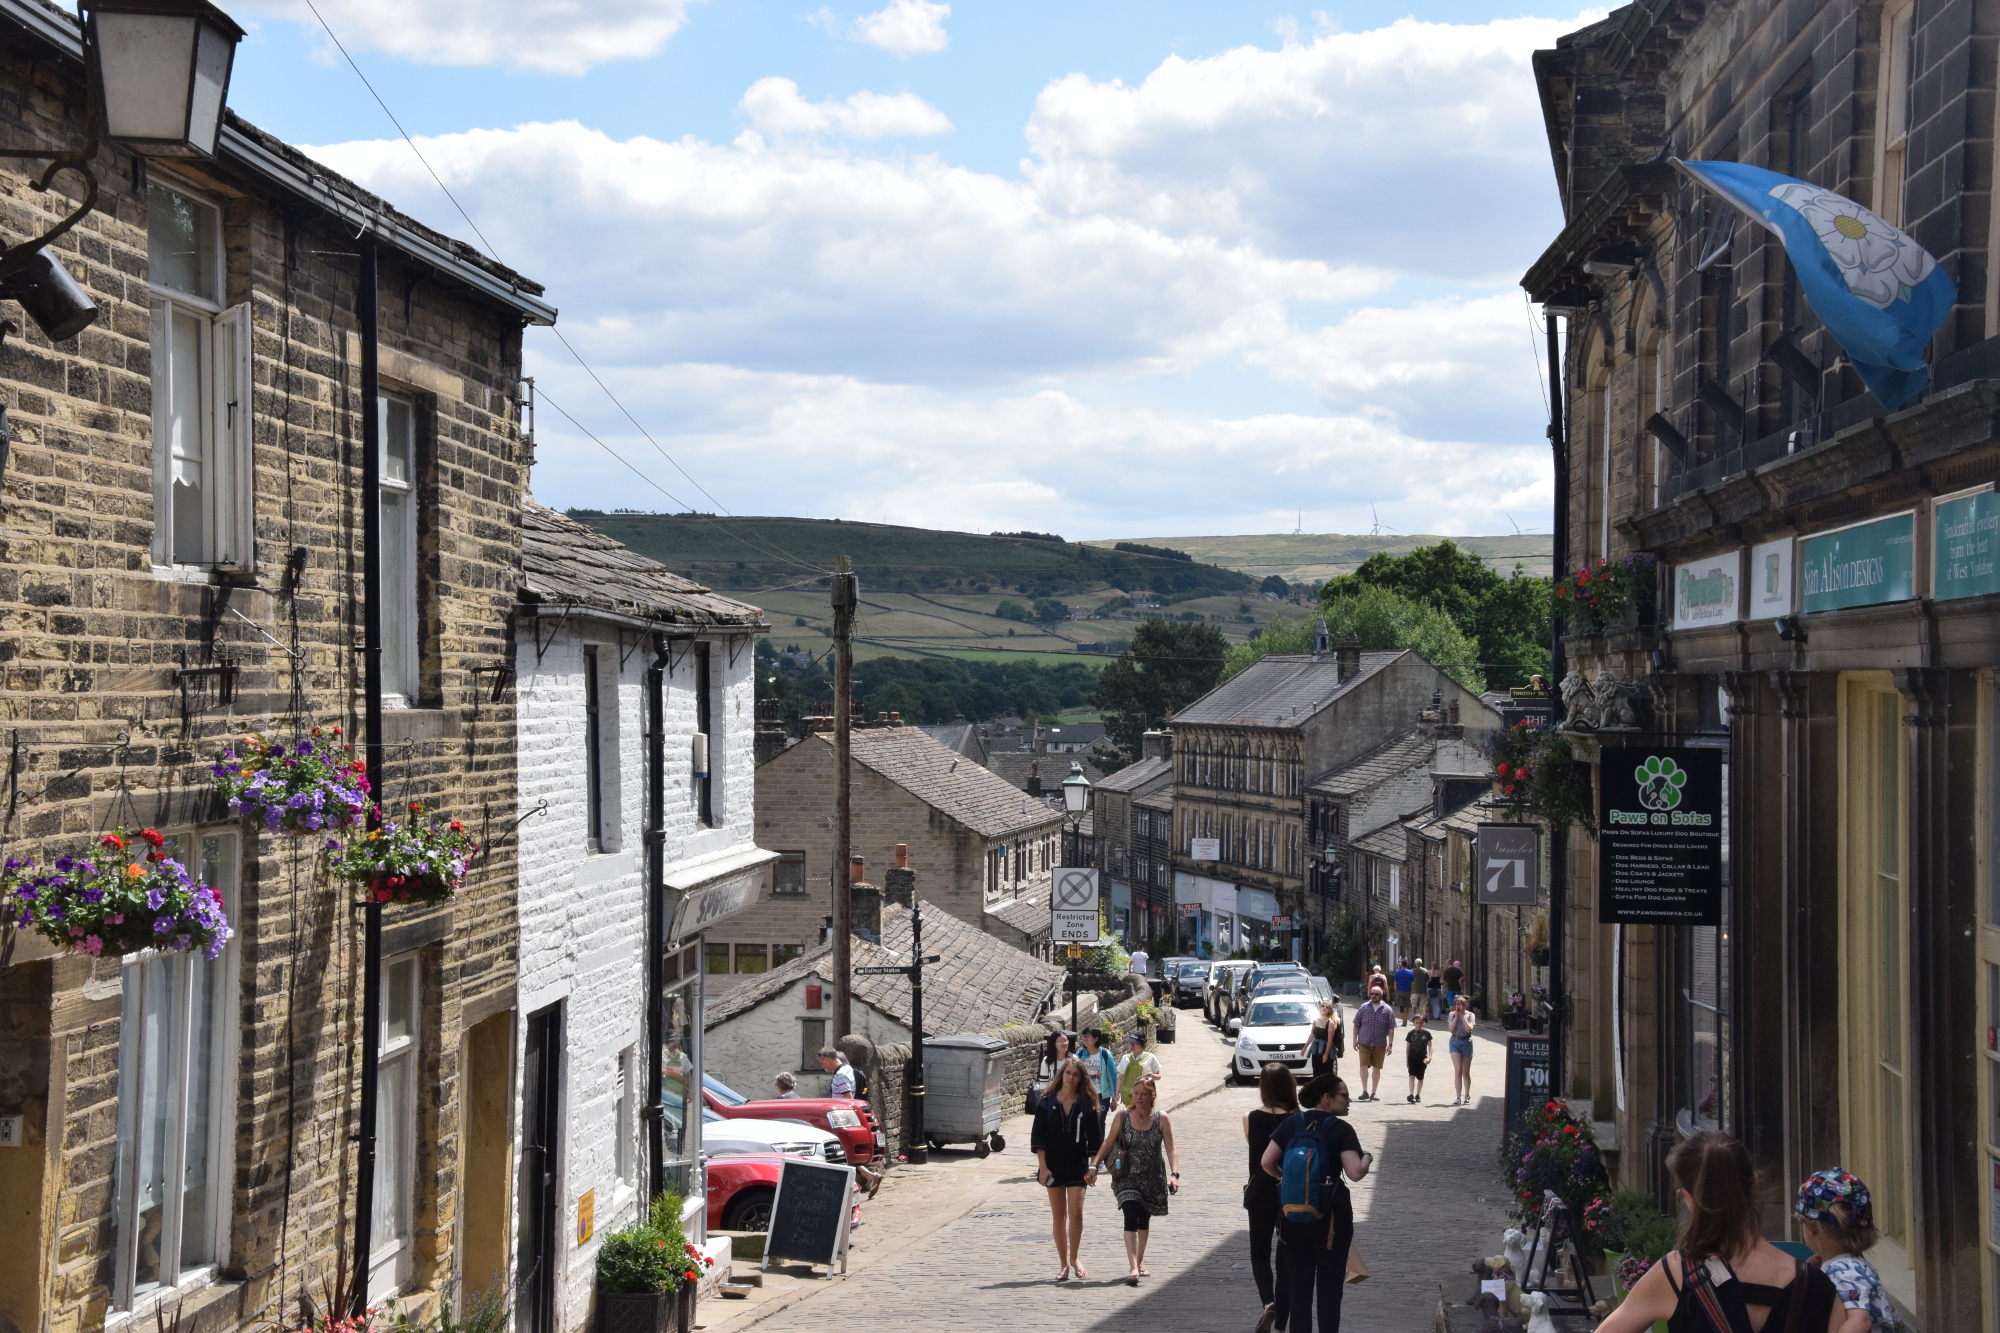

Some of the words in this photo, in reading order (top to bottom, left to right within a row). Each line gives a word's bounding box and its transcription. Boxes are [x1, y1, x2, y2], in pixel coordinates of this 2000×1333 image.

[1820, 552, 1849, 592] Alison
[1953, 563, 1968, 579] West
[1609, 809, 1648, 824] Paws
[1650, 812, 1668, 825] on
[1671, 810, 1712, 826] Sofas
[1485, 856, 1529, 893] 71
[1056, 913, 1095, 921] Restricted
[1061, 930, 1089, 938] ENDS
[864, 967, 882, 975] Railway
[1513, 1042, 1530, 1050] THE
[792, 1209, 821, 1228] TAROT
